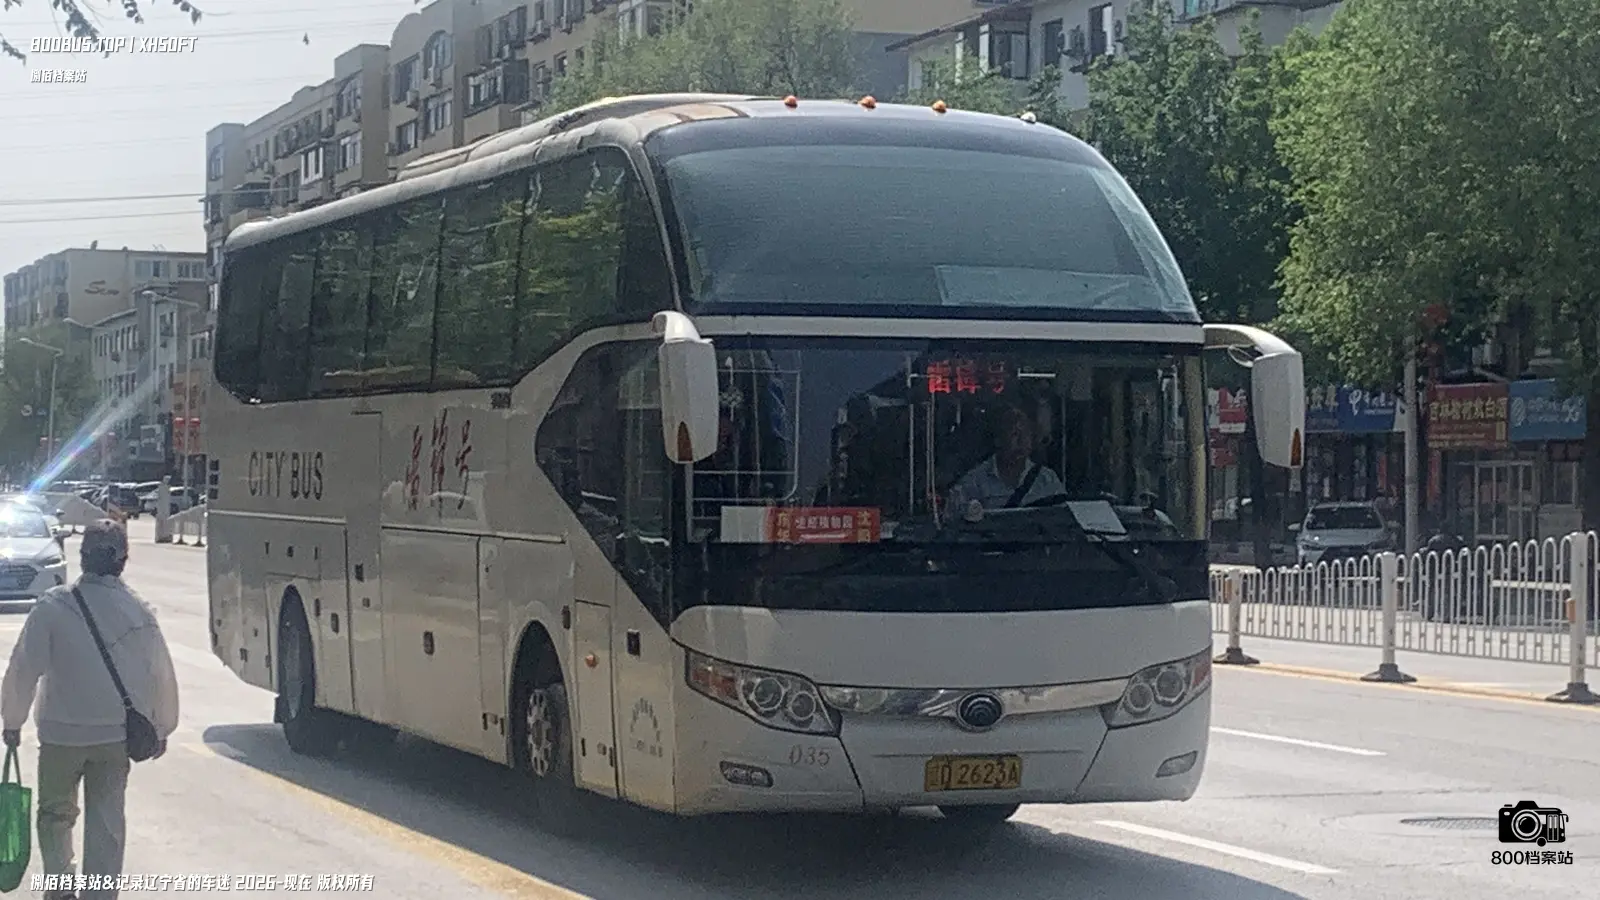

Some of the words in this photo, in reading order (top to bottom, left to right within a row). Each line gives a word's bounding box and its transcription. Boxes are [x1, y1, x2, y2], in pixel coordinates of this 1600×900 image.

[248, 451, 287, 498] CITY
[290, 451, 323, 500] BUS
[788, 745, 831, 767] 035
